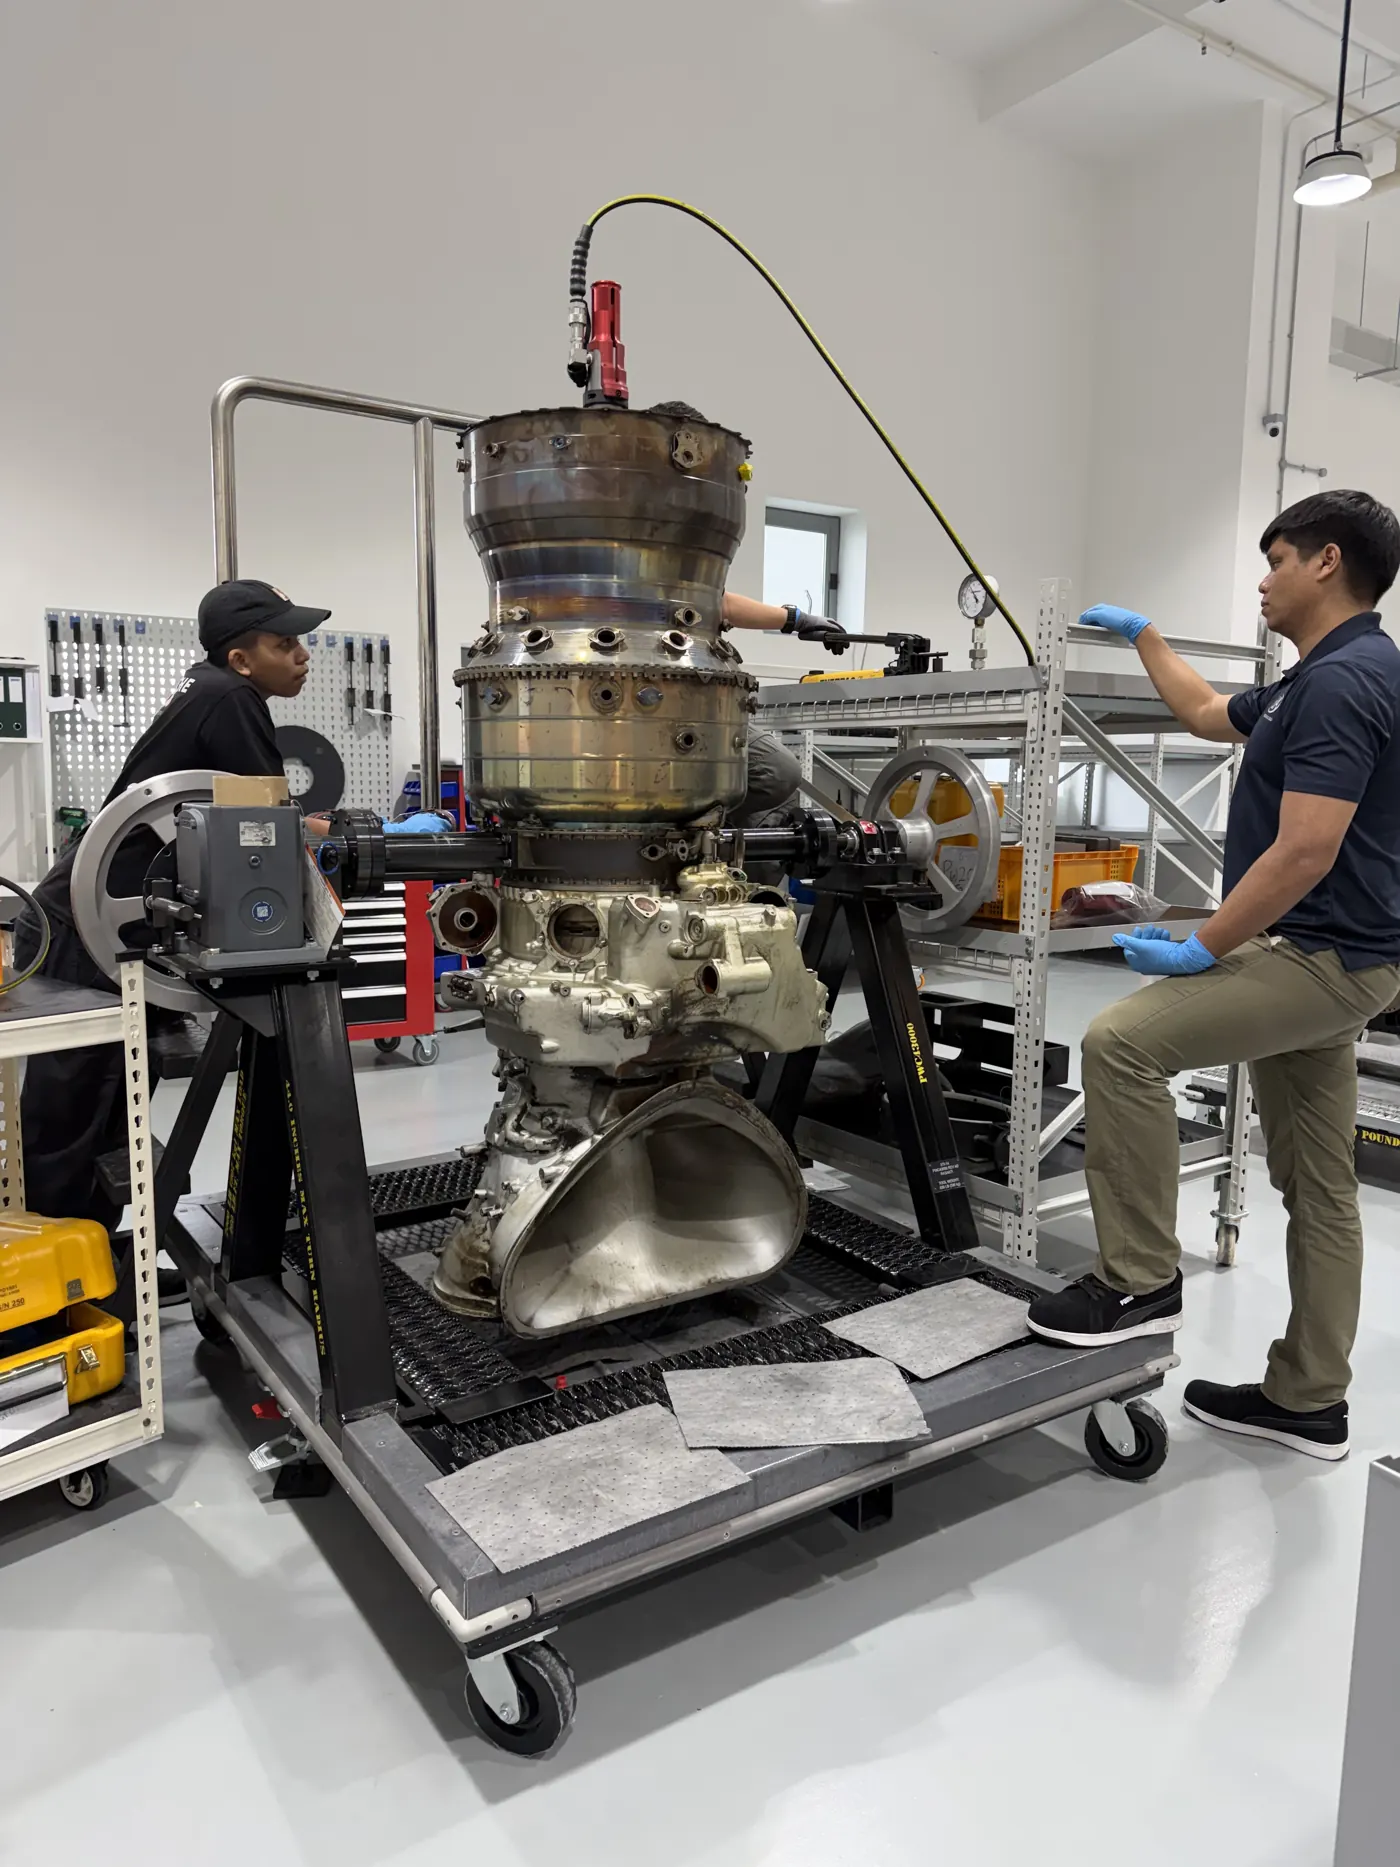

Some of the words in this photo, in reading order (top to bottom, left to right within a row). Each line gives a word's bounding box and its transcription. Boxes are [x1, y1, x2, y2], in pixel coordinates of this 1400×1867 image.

[906, 1022, 927, 1084] PWC43000
[290, 1118, 302, 1182] INCHES
[299, 1190, 308, 1228] MAX
[305, 1233, 316, 1281] TURN
[312, 1288, 326, 1356] RADIUS
[11, 1297, 25, 1307] 250
